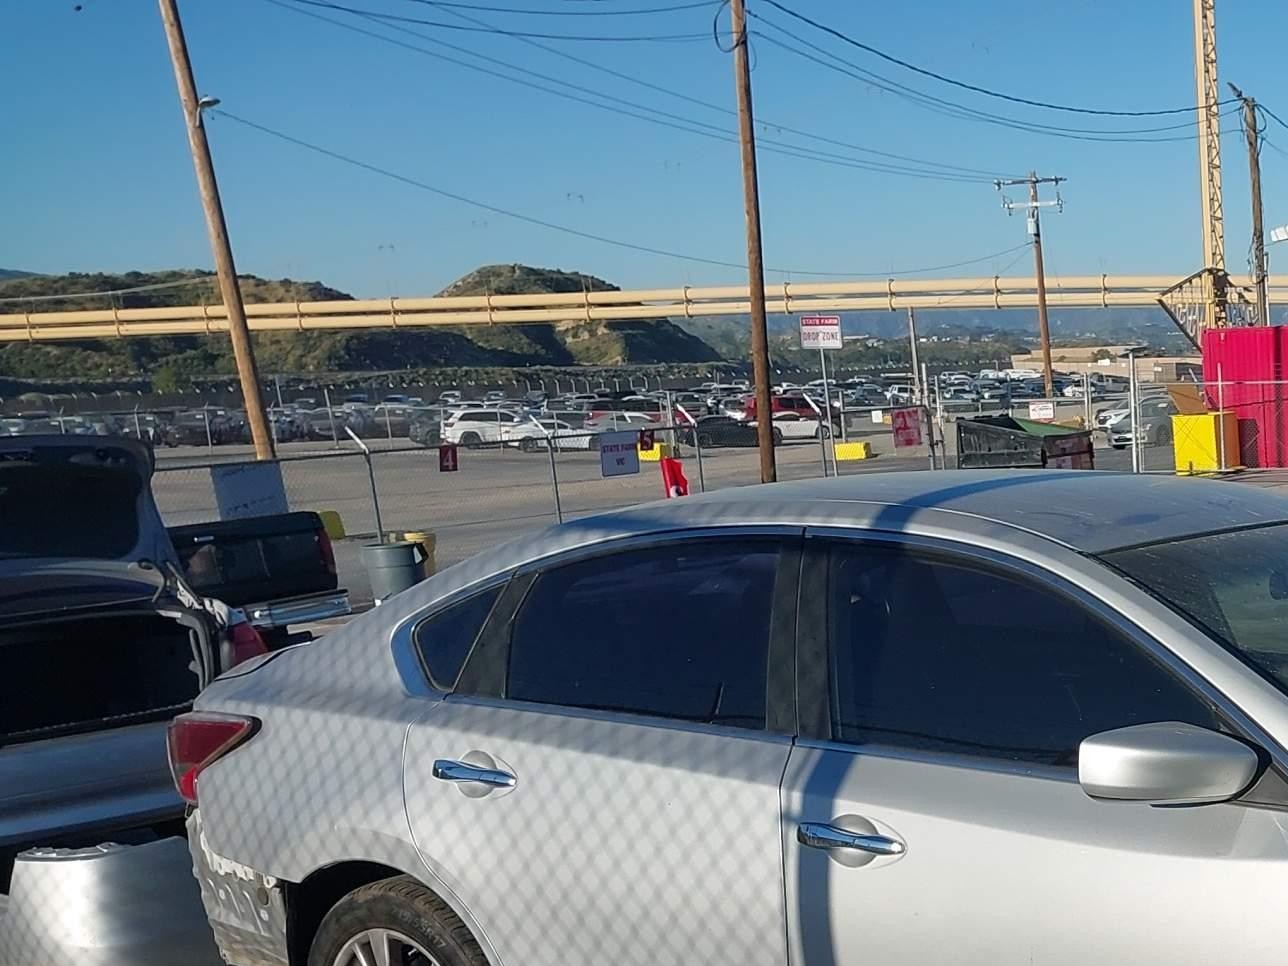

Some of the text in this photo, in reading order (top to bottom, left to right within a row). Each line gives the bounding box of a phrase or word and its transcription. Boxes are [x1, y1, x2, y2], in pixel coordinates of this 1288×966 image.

[802, 331, 838, 341] DROP ZONE
[443, 449, 454, 469] 4
